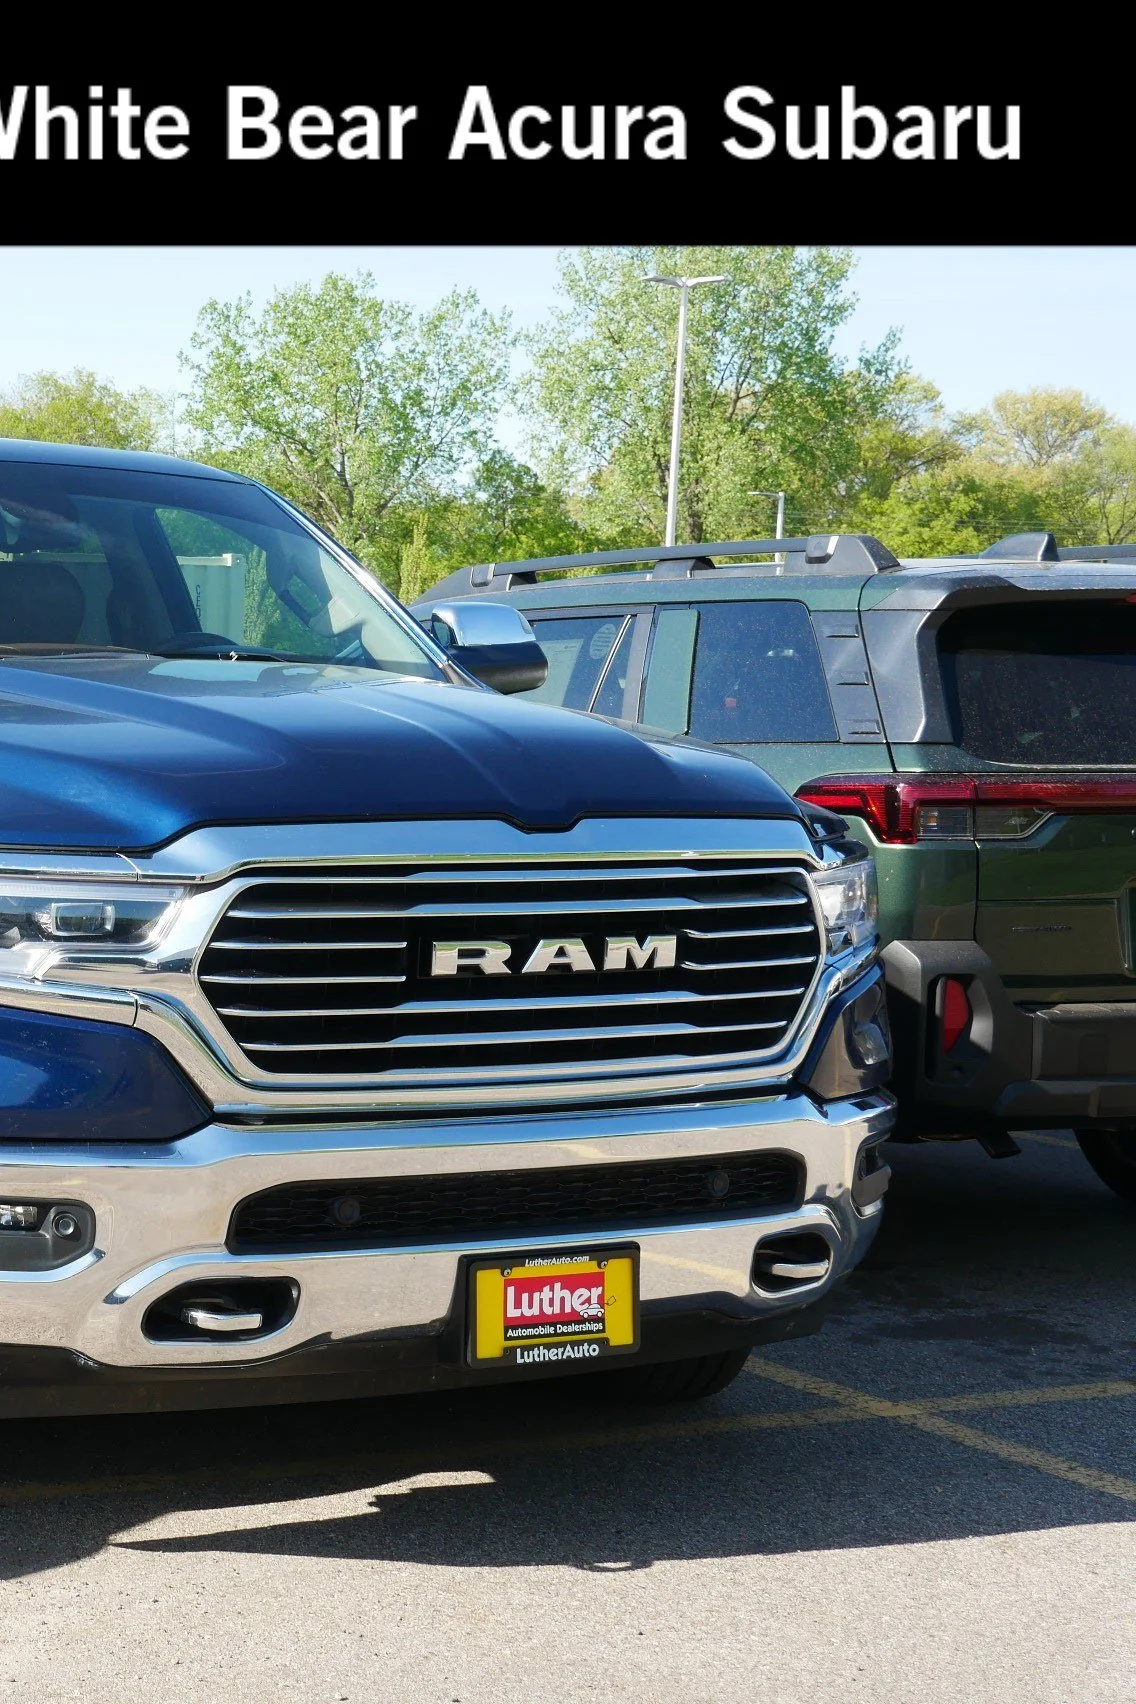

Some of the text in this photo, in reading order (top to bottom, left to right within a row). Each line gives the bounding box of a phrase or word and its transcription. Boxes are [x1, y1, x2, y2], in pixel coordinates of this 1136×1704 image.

[431, 935, 677, 976] RAM
[524, 1256, 590, 1267] LutherAuto.com
[506, 1282, 602, 1318] Luther
[507, 1321, 603, 1338] Automobile Dealerships
[516, 1342, 600, 1364] LutherAuto
